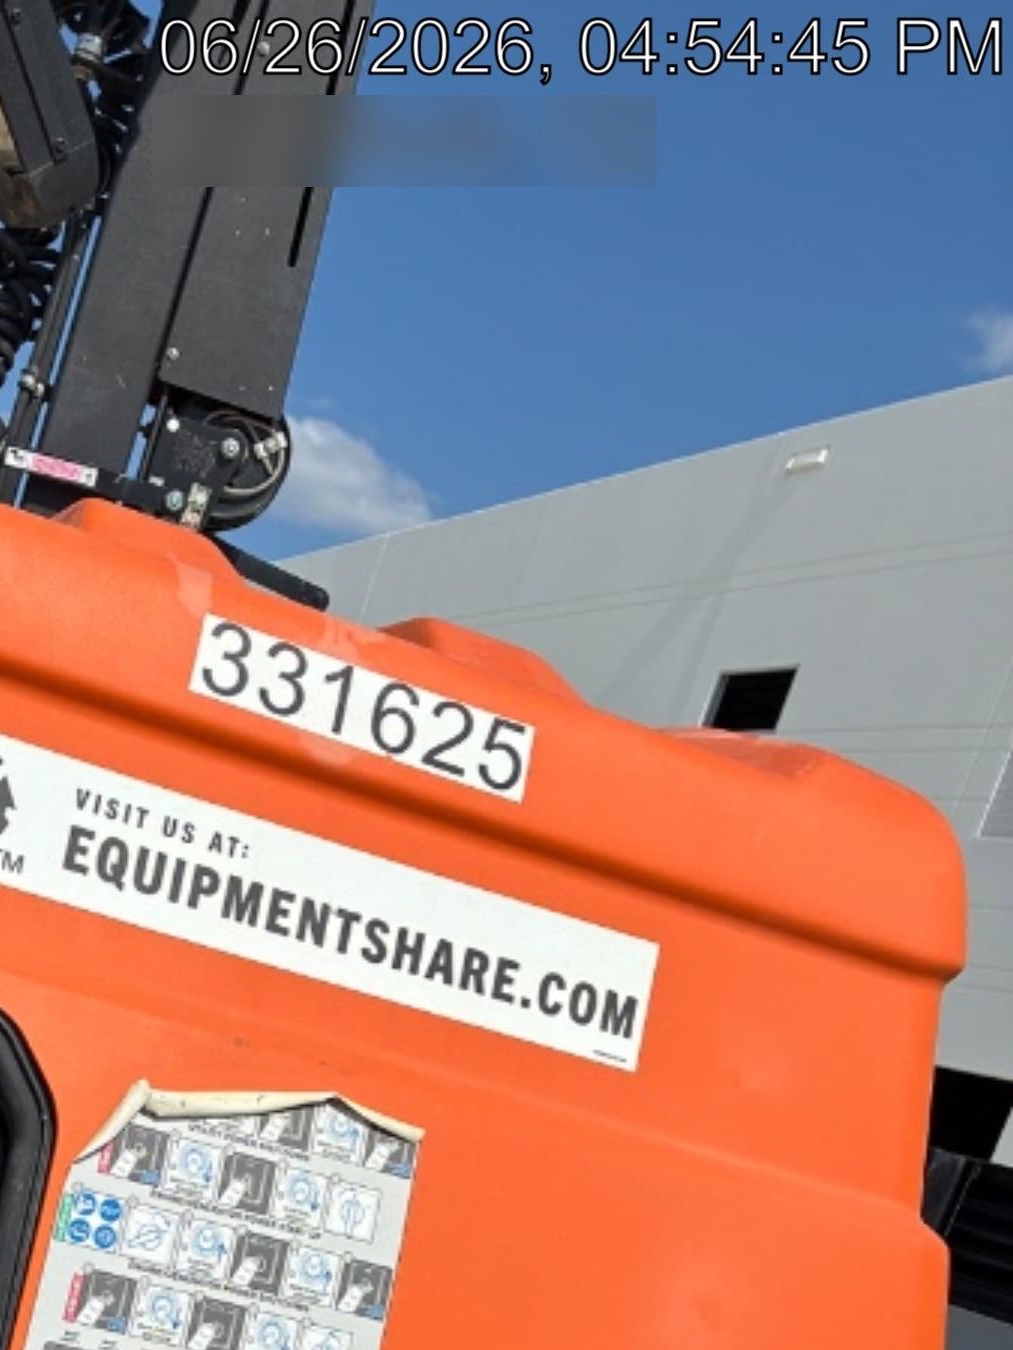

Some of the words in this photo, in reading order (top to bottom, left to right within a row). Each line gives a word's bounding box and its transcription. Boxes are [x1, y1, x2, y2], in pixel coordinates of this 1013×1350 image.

[203, 623, 525, 790] 331625
[76, 788, 150, 828] VISIT
[162, 816, 196, 844] US
[208, 832, 250, 858] AT:
[64, 826, 636, 1038] EQUIPMENTSHARE.COM
